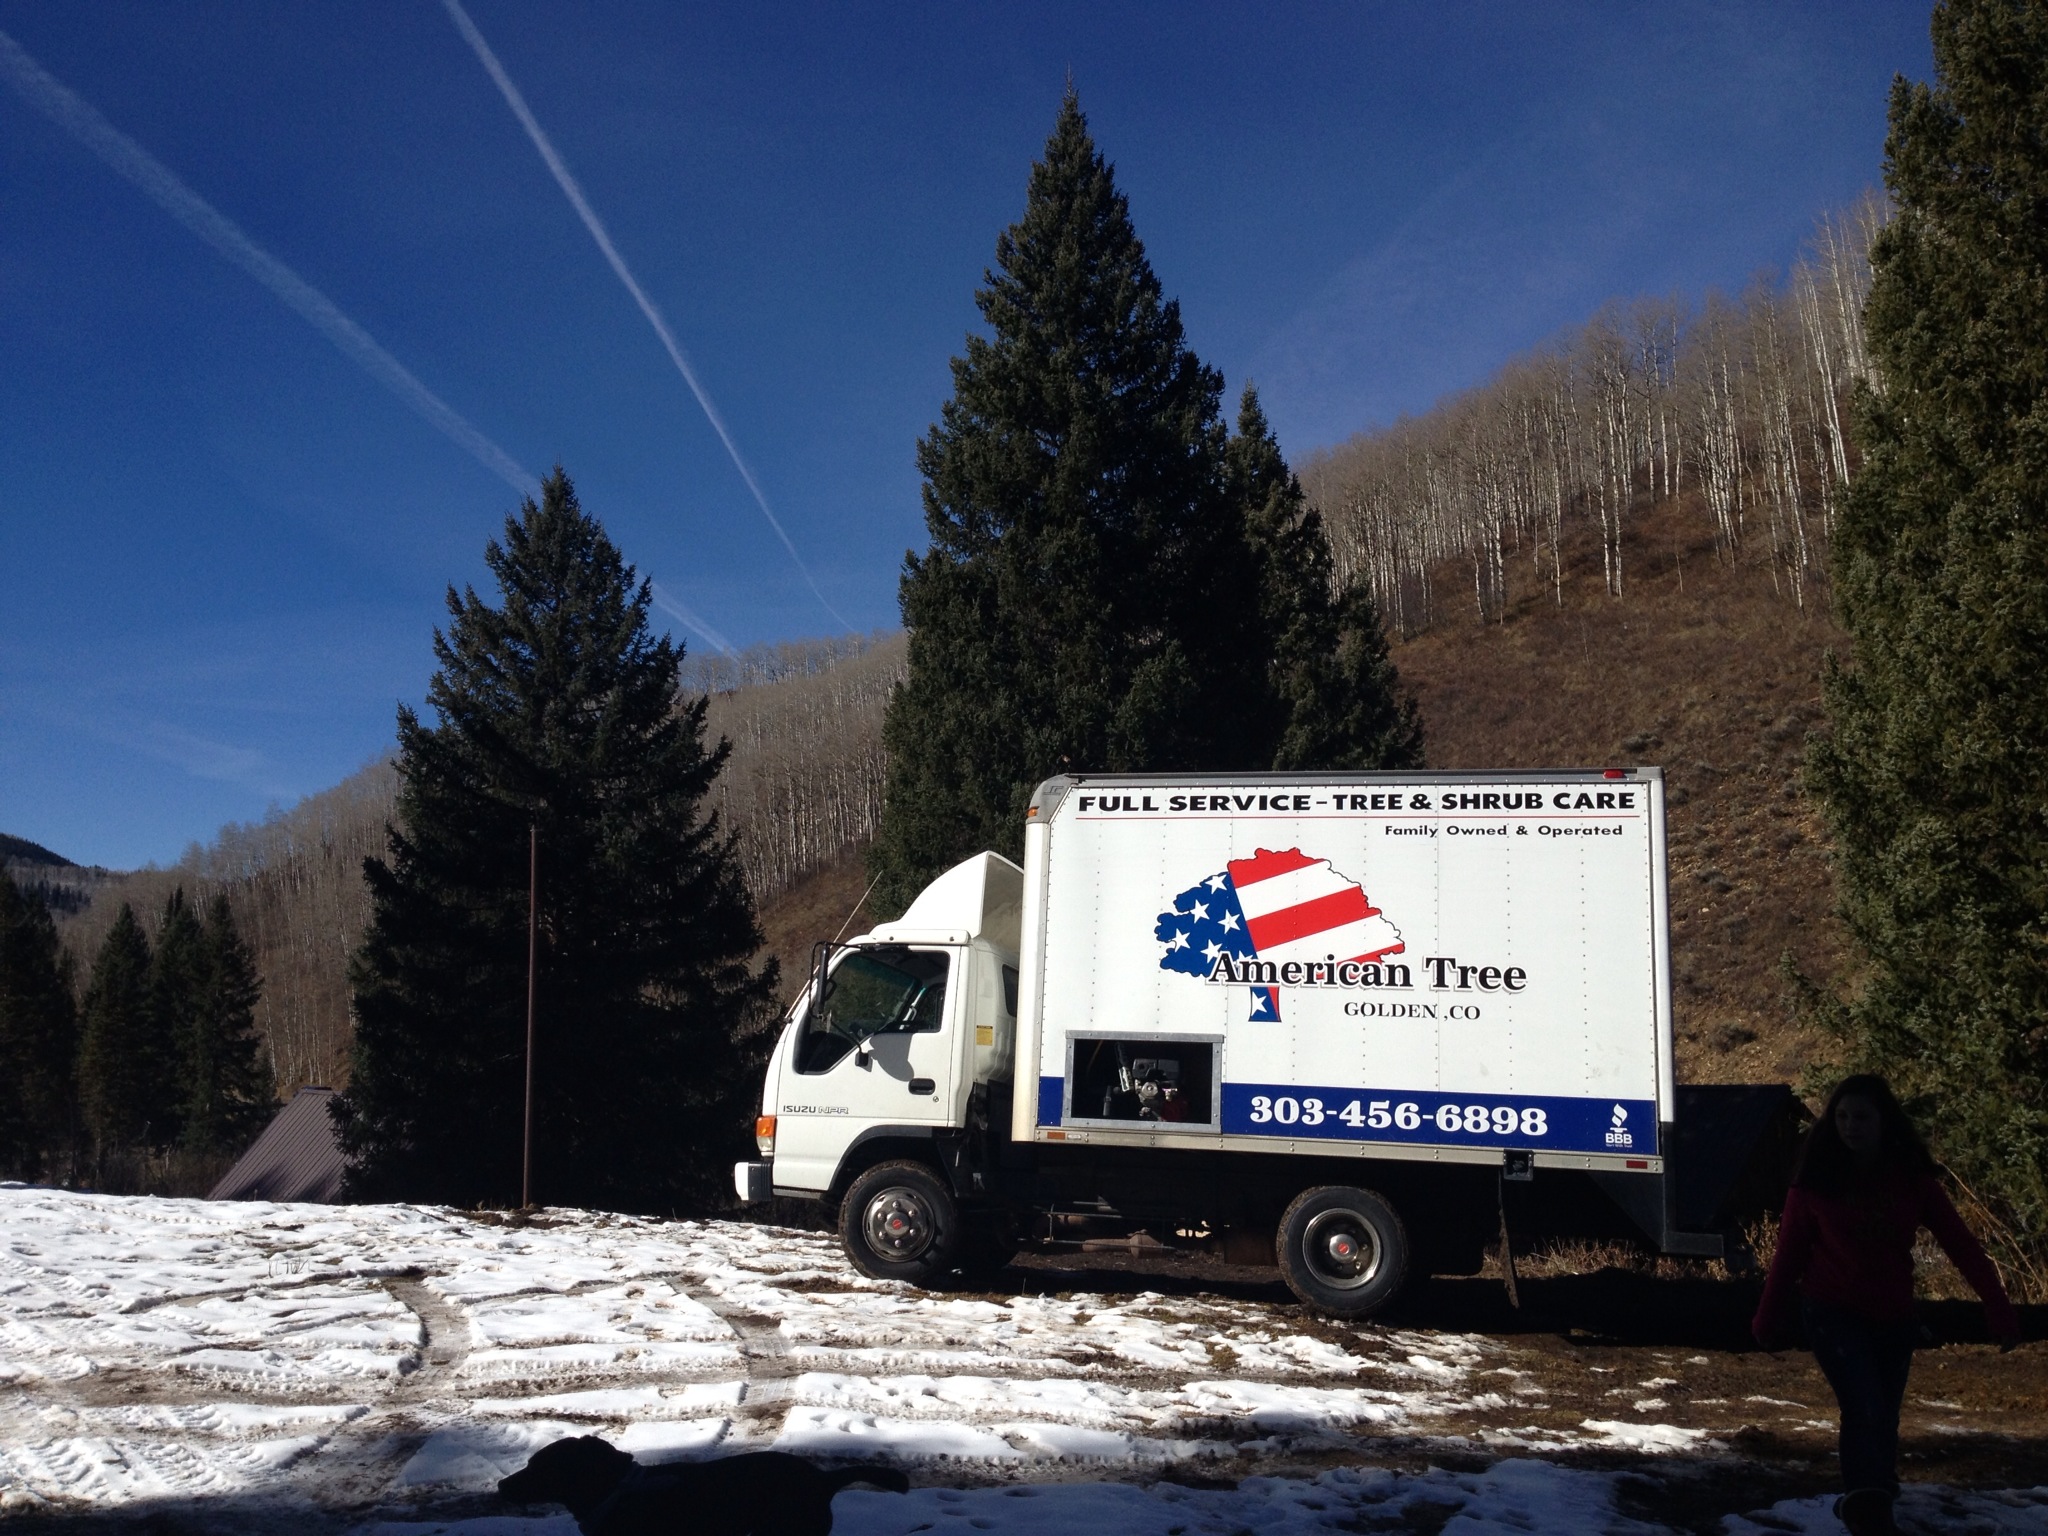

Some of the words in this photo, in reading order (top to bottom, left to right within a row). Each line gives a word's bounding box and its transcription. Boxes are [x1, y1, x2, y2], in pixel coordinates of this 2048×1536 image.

[1078, 795, 1160, 812] FULL
[1169, 794, 1311, 812] SERVICE
[1332, 793, 1403, 810] TREE
[1409, 793, 1432, 810] &
[1441, 792, 1544, 810] SHRUB
[1552, 792, 1635, 810] CARE
[1385, 824, 1439, 839] Family
[1446, 824, 1507, 837] Owned
[1516, 825, 1528, 837] &
[1537, 824, 1623, 839] Operated
[1208, 952, 1413, 988] American
[1425, 957, 1527, 991] Tree
[1344, 1001, 1438, 1019] GOLDEN
[783, 1105, 816, 1114] ISUZU
[818, 1106, 849, 1115] NPR
[1249, 1095, 1548, 1137] 303-456-6898
[1605, 1132, 1633, 1145] BBB
